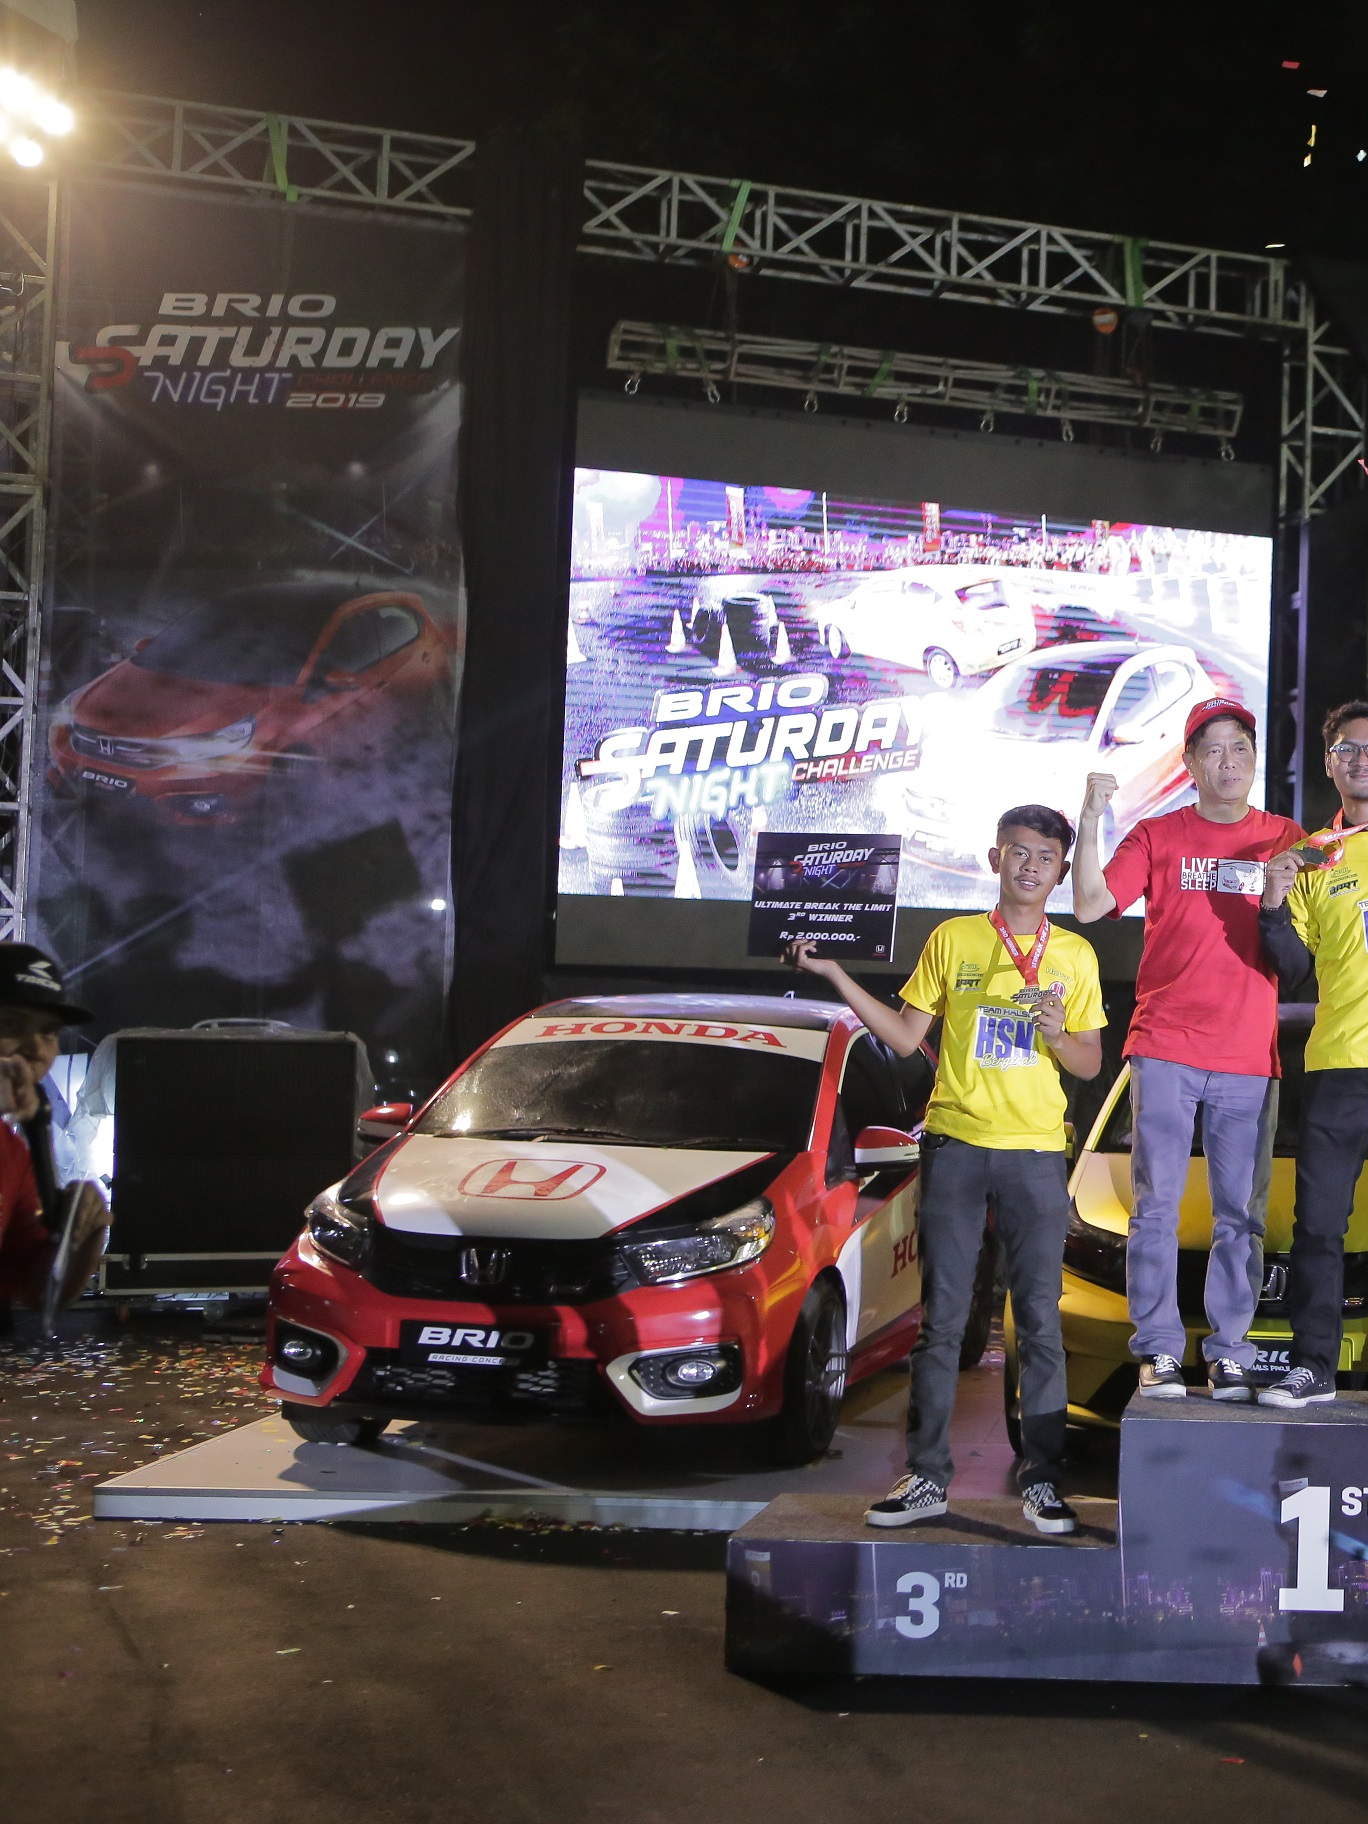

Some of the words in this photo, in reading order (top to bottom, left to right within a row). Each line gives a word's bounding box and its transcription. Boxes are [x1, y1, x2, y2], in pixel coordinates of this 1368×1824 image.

[158, 293, 336, 318] BRIO
[77, 324, 460, 388] SATURDAY
[143, 370, 293, 411] NIGHT
[286, 392, 386, 409] 2019
[655, 677, 826, 722] BRIO
[791, 749, 919, 781] CHALLENGE
[82, 771, 128, 788] BRIO
[646, 762, 791, 821] NIGHT
[807, 841, 847, 852] BRIO
[788, 848, 874, 872] SATURDAY
[1181, 857, 1218, 873] LIVE
[803, 864, 836, 877] NIGHT
[1182, 872, 1216, 881] BREATHE
[1180, 880, 1217, 891] SLEEP
[754, 901, 802, 909] ULTIMATE
[804, 902, 840, 910] BREAK
[842, 903, 862, 911] THE
[864, 904, 893, 912] LIMIT
[809, 913, 853, 922] WINNER
[978, 1005, 1001, 1015] TEAM
[1004, 1009, 1030, 1018] HALS
[535, 1021, 787, 1048] HONDA
[975, 1016, 1035, 1058] HSN
[417, 1326, 534, 1349] BRIO
[432, 1355, 468, 1363] RACING
